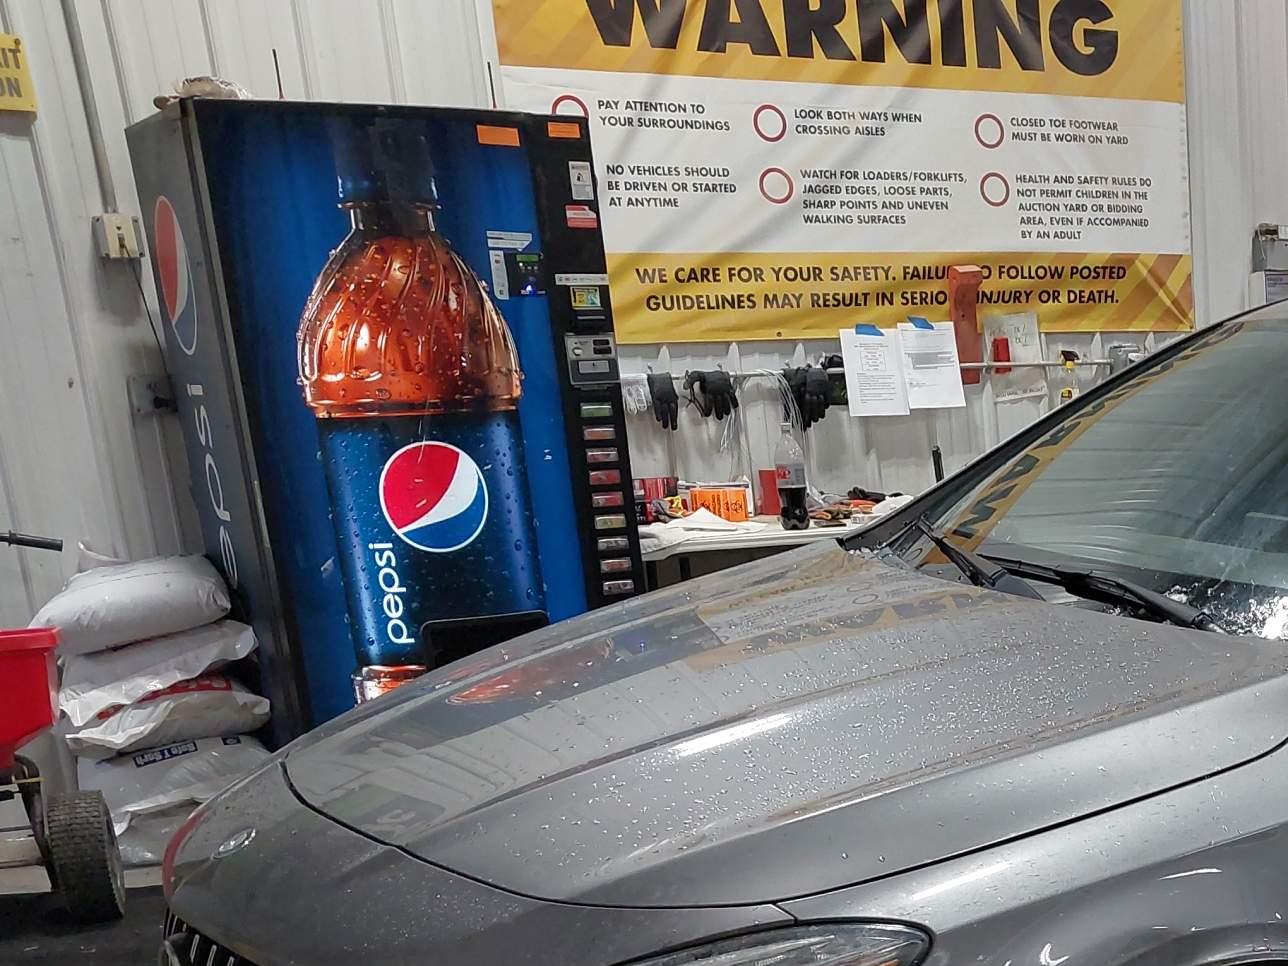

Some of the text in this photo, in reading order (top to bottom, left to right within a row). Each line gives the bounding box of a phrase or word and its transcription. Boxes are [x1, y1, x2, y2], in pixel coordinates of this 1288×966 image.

[598, 100, 705, 114] PAY ATTENTION TO
[794, 109, 922, 123] LOOK BOTH WAYS WHEN
[599, 116, 730, 131] YOUR SURROUNDINGS
[795, 124, 886, 136] CROSSING AISLES
[1010, 117, 1118, 131] CLOSED TOE FOOTWEAR
[1011, 132, 1129, 145] MUST BE WORN ON YARD
[606, 164, 730, 178] NO VEHICLES SHOULD
[800, 169, 968, 184] WATCH FOR LOADERS/FORKLIFTS,
[607, 181, 737, 193] BE DRIVEN OR STARTED
[1015, 174, 1152, 187] HEALTH AND SAFETY RULES DO
[802, 184, 953, 198] JAGGED EDGES, LOOSE PARTS,
[1017, 188, 1148, 200] NOT PERMIT CHILDREN IN THE
[609, 197, 680, 208] AT ANYTIME
[802, 199, 949, 210] SHARP POINTS AND UNEVEN
[1018, 203, 1143, 214] AUCTION YARD OR BIDDING
[803, 215, 906, 225] WALKING SURFACES
[1019, 216, 1149, 227] AREA, EVEN IF ACCOMPANIED
[1021, 230, 1082, 240] BY AN ADULT
[635, 265, 1127, 284] WE CARE FOR YOUR SAFETY. FAILU O FOLLOW POSTED
[646, 290, 1119, 311] GUIDELINES MAY RESULT IN SERIO INJURY OR DEATH.
[369, 542, 416, 643] pepsi
